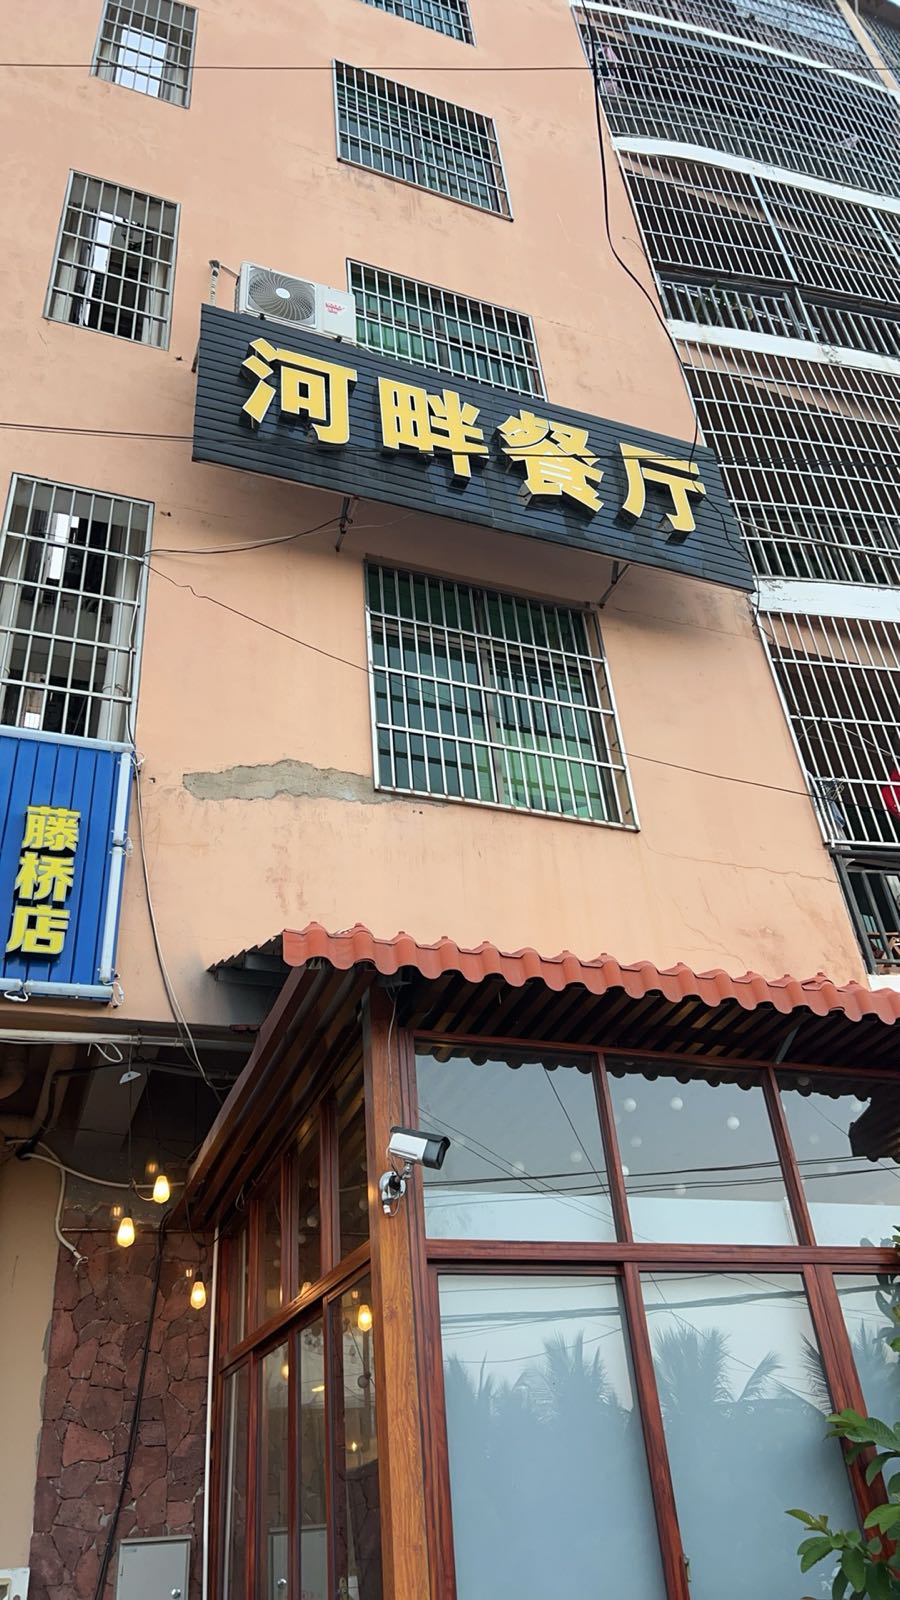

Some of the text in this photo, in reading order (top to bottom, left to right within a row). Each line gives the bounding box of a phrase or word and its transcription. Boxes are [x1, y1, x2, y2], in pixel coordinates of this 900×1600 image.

[242, 338, 706, 533] 河畔餐厅
[6, 805, 81, 955] 藤桥店
